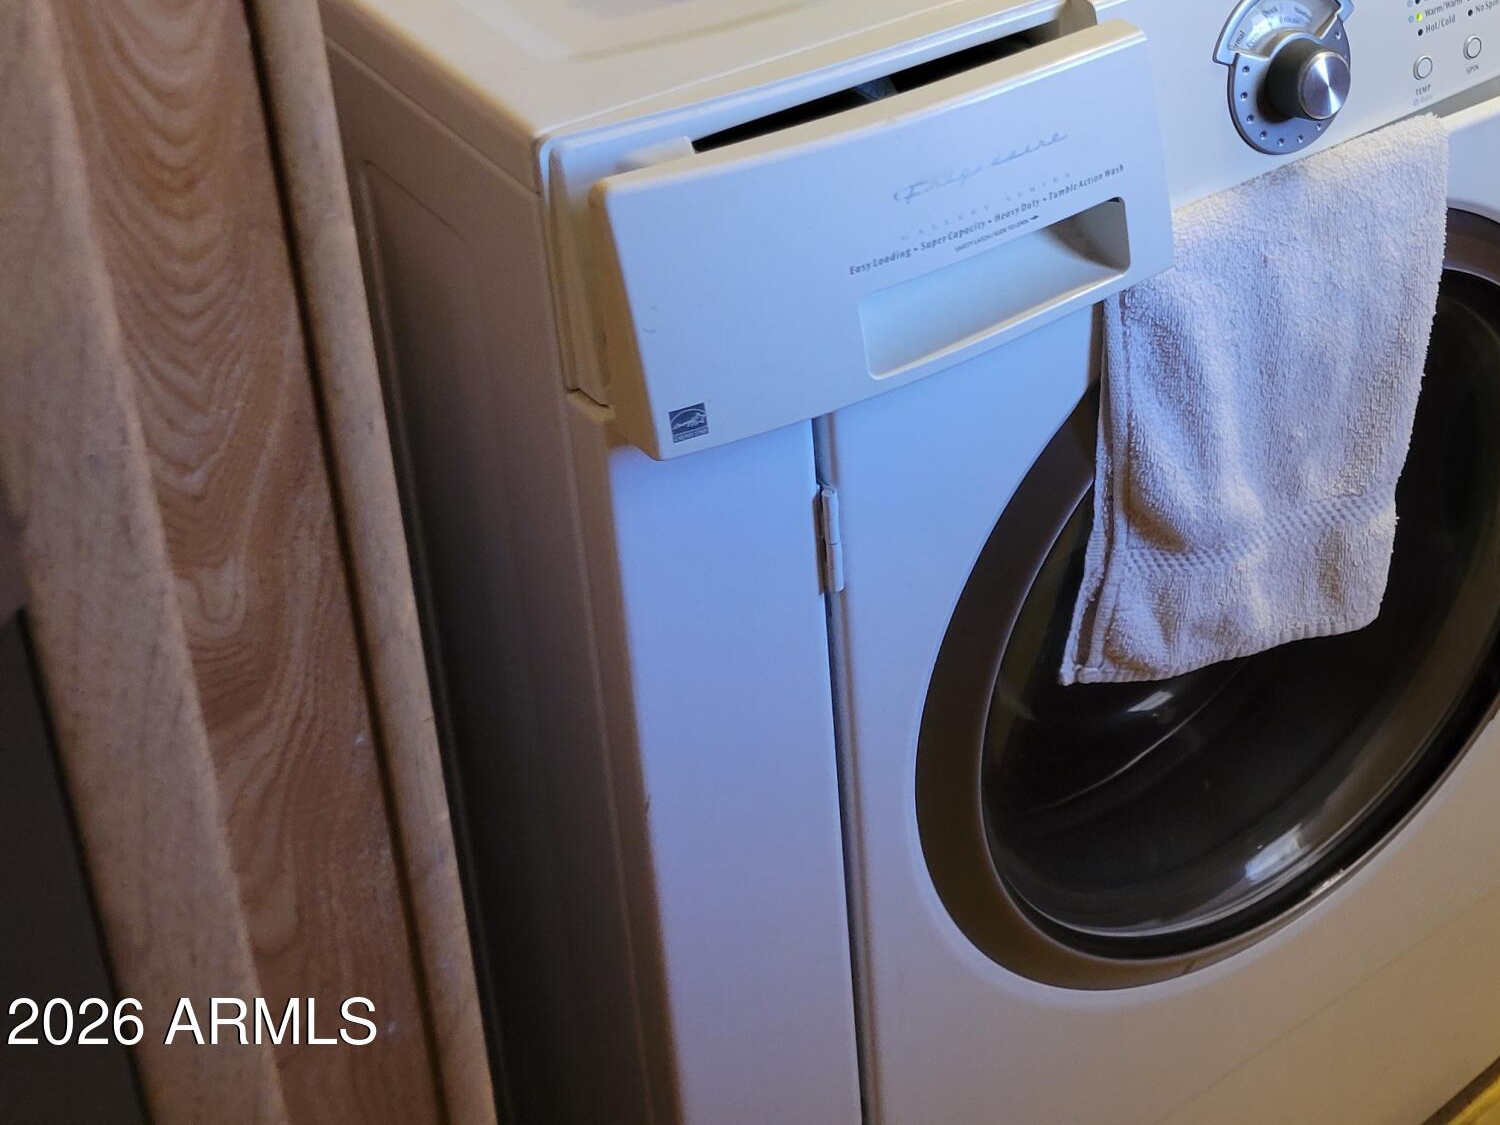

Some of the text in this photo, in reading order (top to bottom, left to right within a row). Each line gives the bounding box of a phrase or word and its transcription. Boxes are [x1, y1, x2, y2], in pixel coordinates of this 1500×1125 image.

[1475, 3, 1484, 13] No
[1425, 14, 1456, 33] Hot/Cold
[1415, 83, 1431, 96] TEMP
[850, 262, 871, 275] Easy
[872, 248, 912, 268] Loading
[920, 235, 947, 251] Super
[947, 219, 987, 241] Capacity
[994, 207, 1020, 223] Heavy
[1020, 198, 1040, 213] Duty
[1048, 182, 1078, 201] Tumble
[1078, 172, 1103, 188] Action
[1103, 163, 1124, 177] Wash
